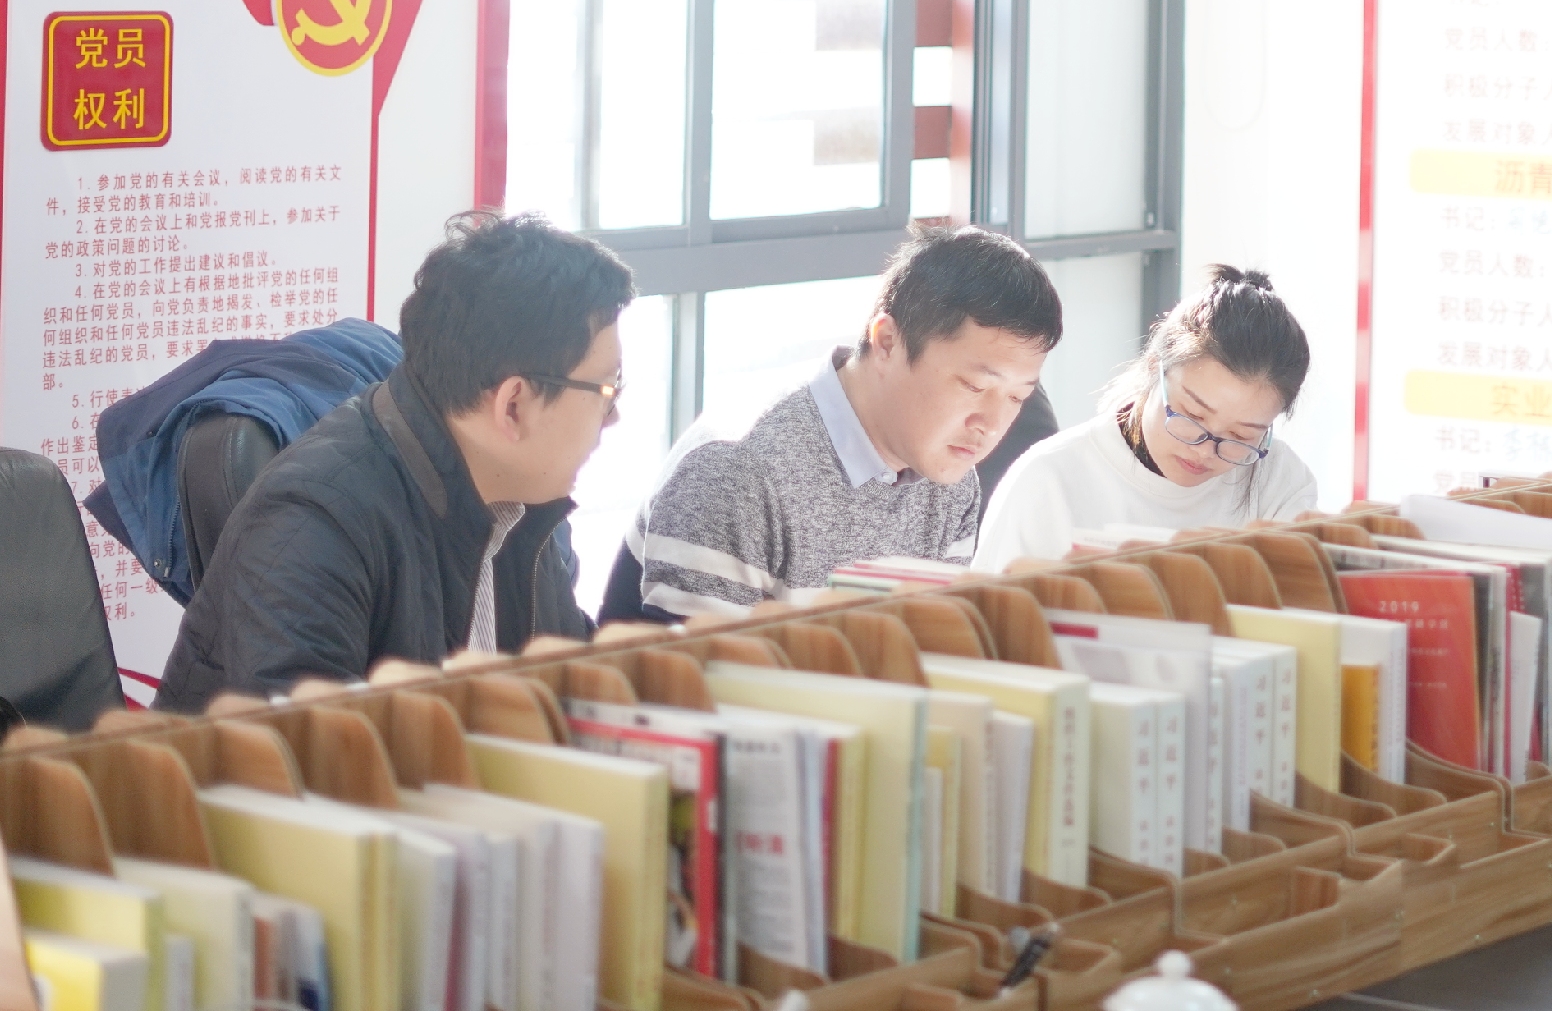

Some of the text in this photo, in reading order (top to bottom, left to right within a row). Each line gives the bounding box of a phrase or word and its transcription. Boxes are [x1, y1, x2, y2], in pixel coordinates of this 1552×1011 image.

[75, 27, 146, 69] 党员
[73, 87, 145, 129] 权利
[42, 372, 63, 391] 部。
